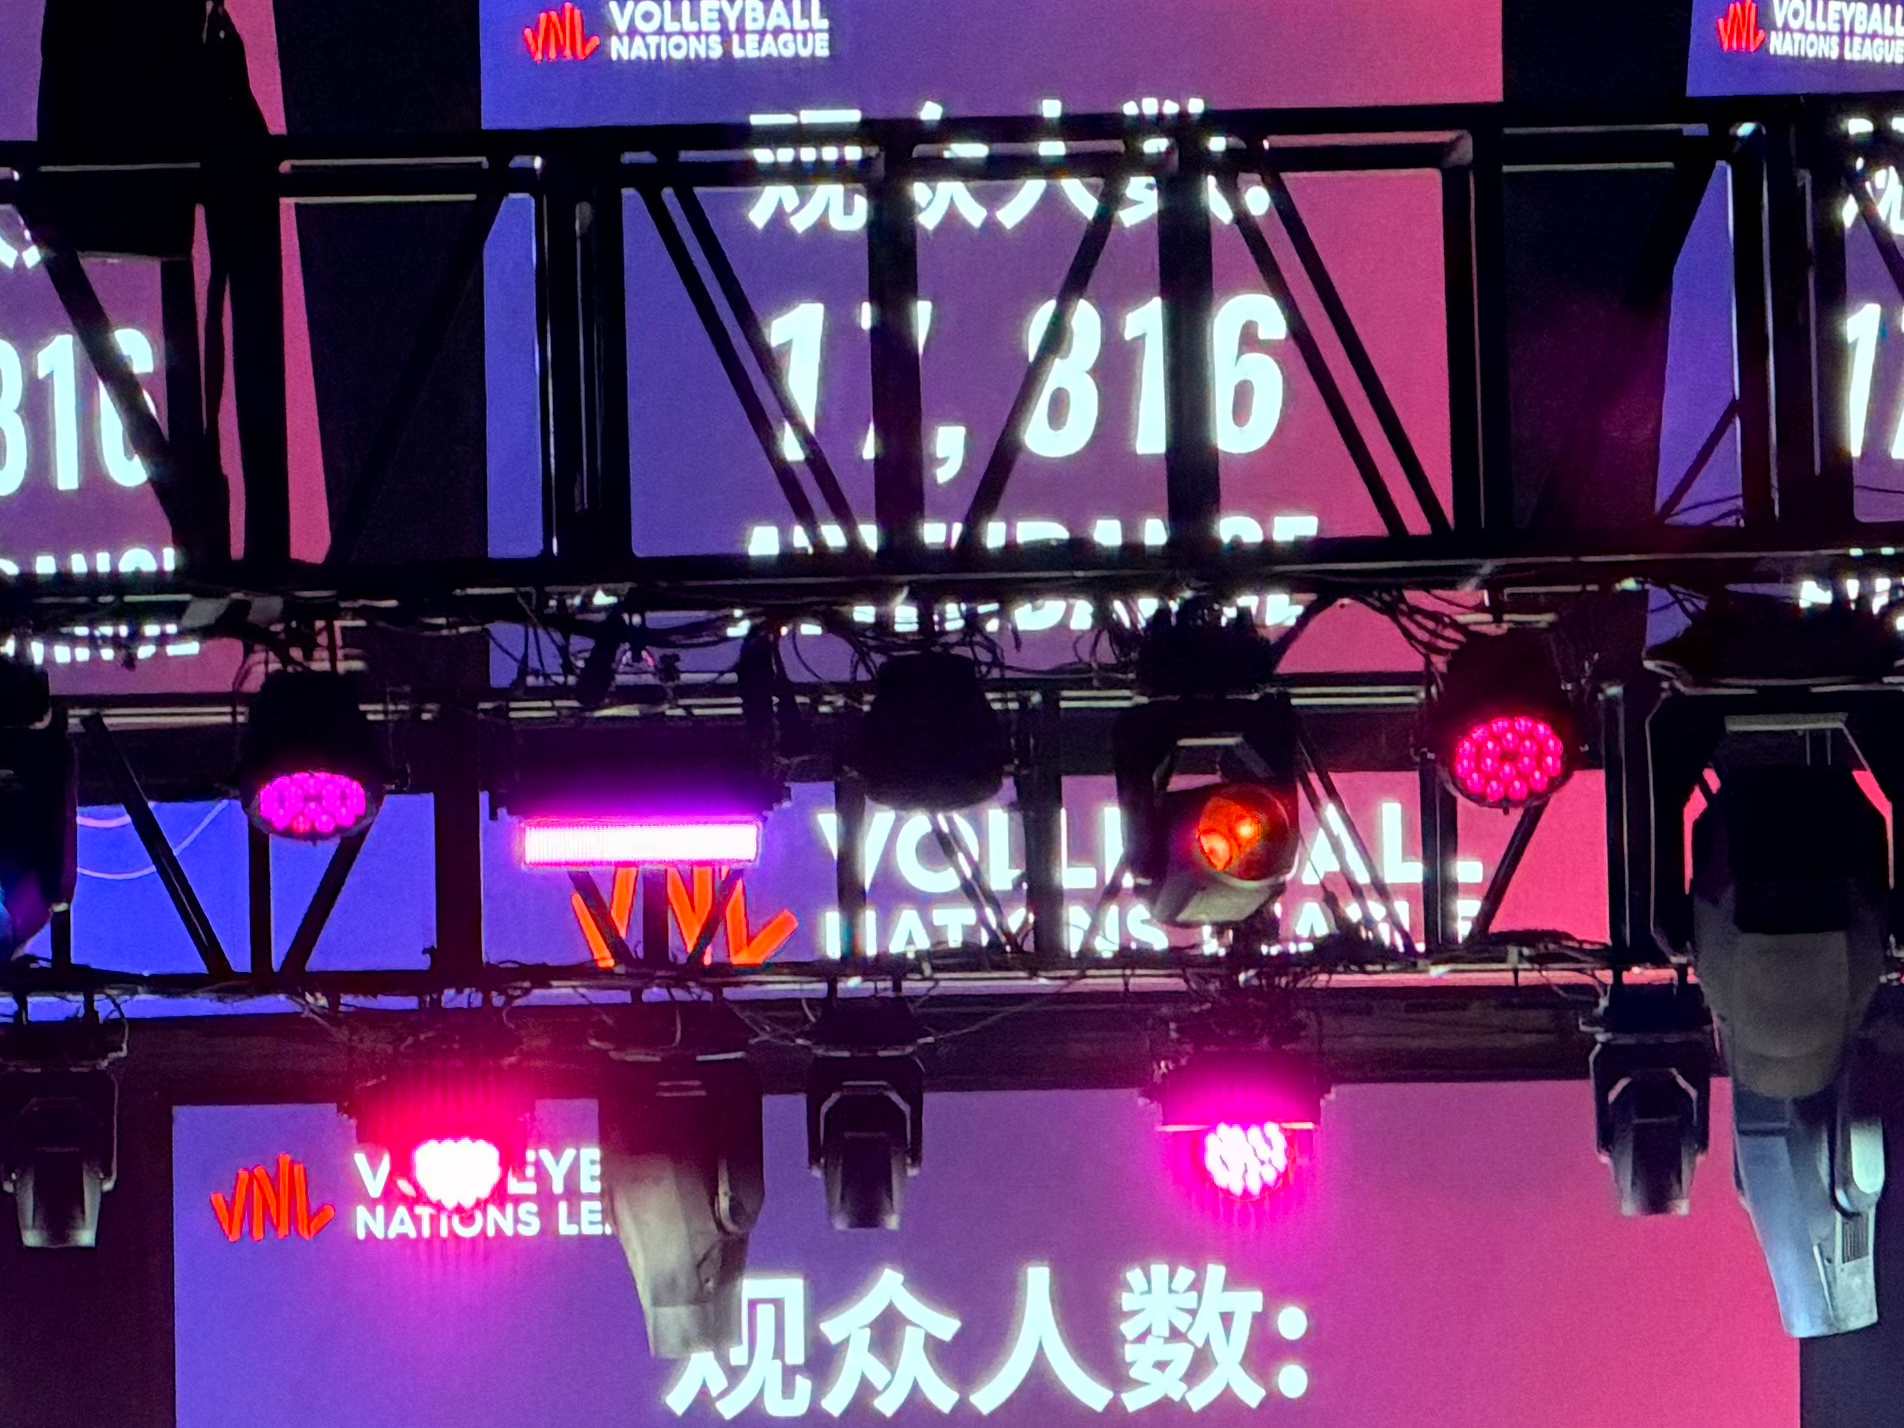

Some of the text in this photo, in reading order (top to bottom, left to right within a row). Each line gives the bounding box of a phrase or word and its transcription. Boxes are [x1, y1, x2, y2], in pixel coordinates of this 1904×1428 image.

[610, 32, 830, 61] NATIONS LEAGUE
[1769, 31, 1839, 60] NATIONS
